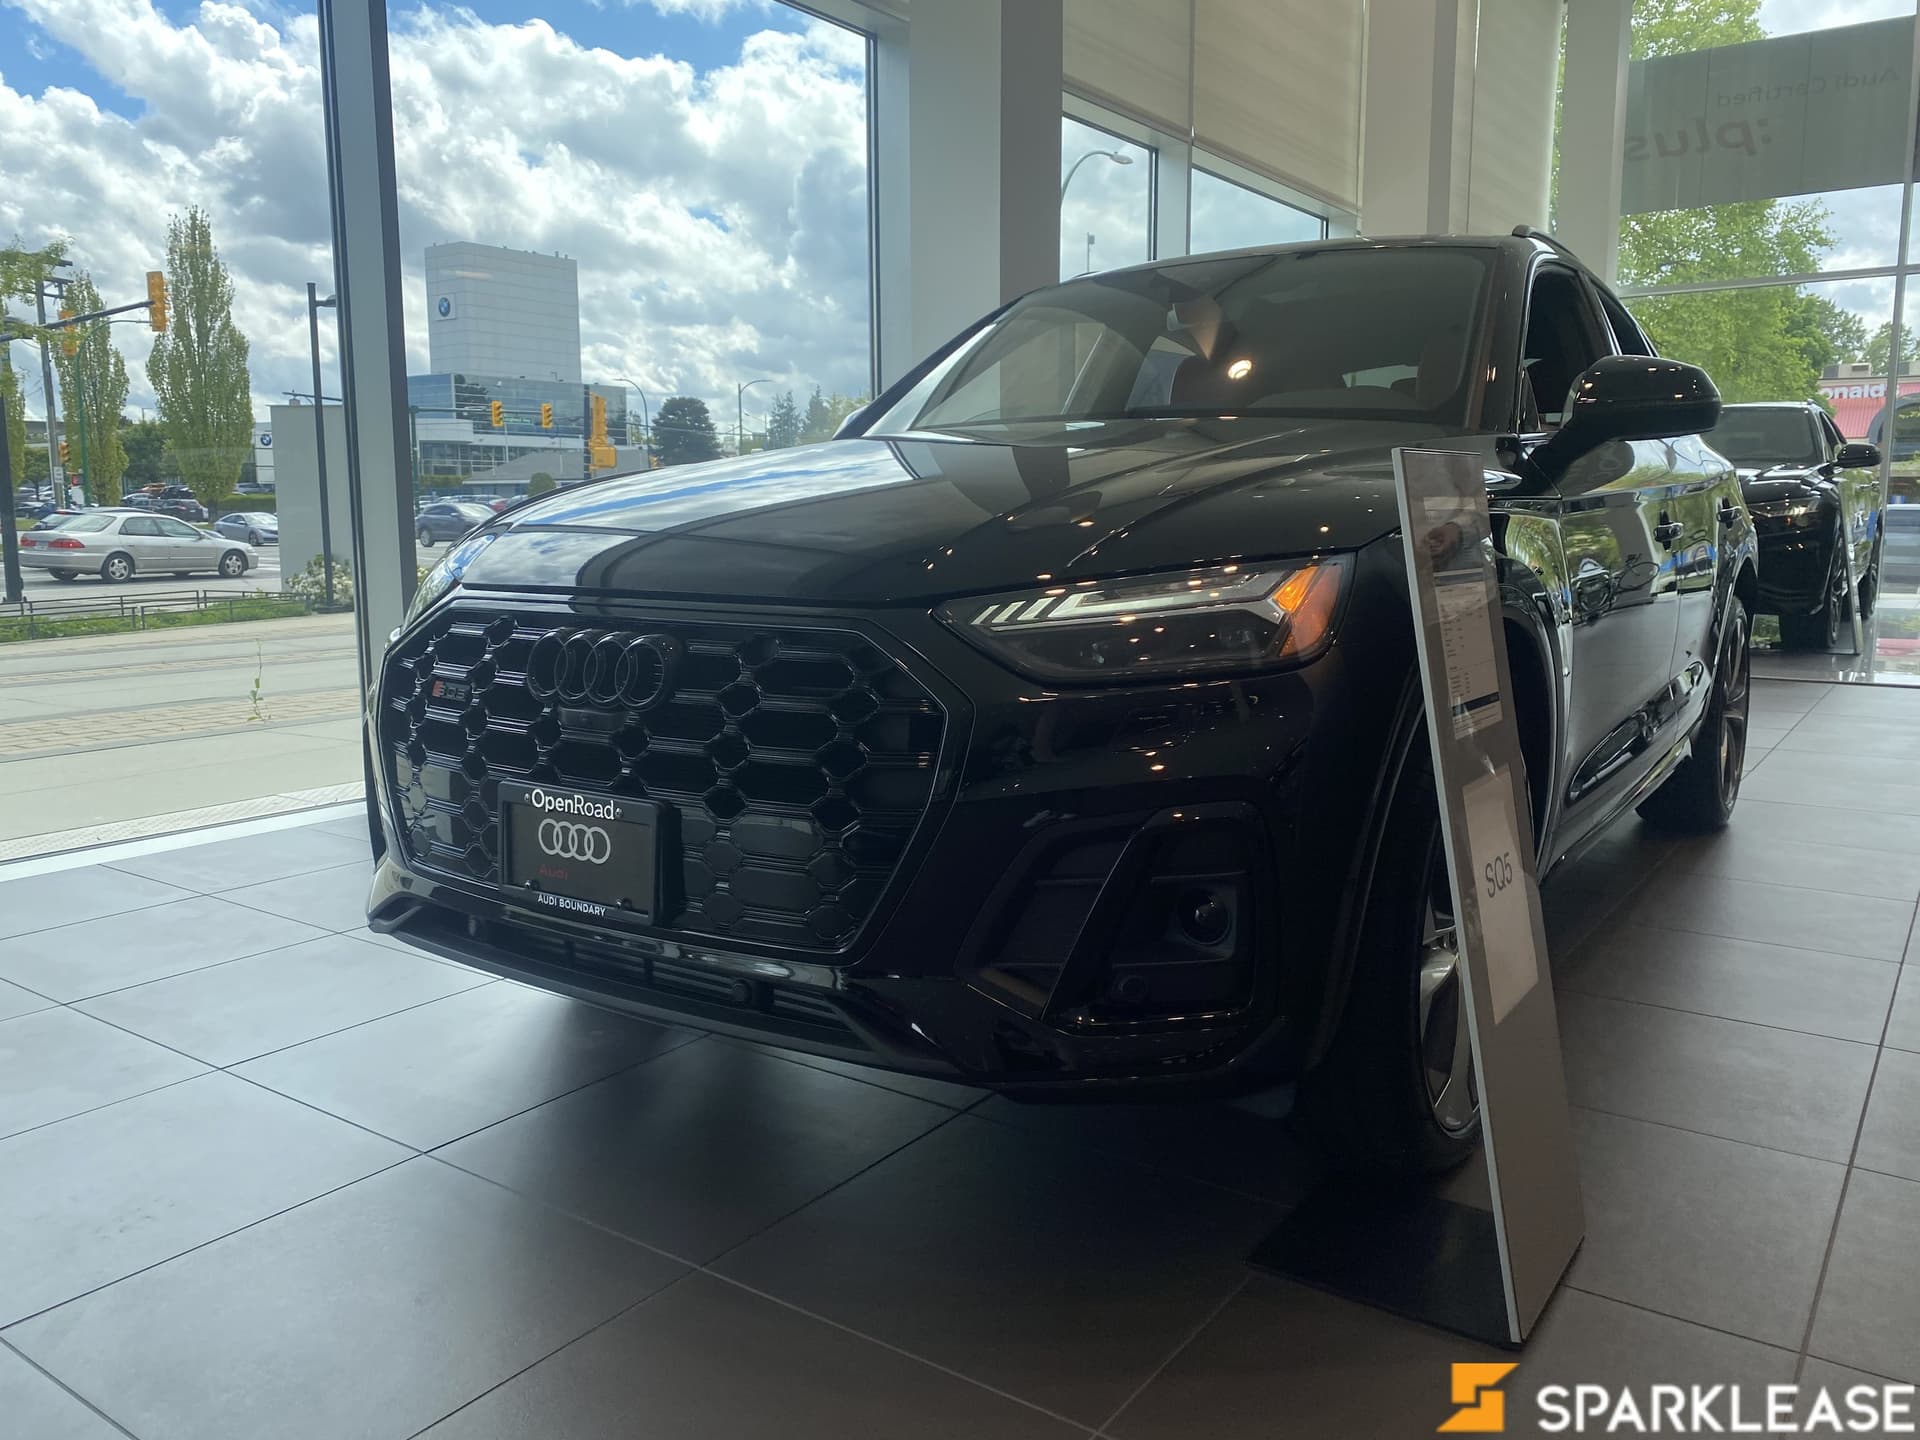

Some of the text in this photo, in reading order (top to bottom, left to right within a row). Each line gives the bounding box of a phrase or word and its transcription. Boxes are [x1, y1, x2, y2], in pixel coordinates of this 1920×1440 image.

[1817, 383, 1900, 401] onald
[531, 788, 615, 820] OpenRoad
[1484, 852, 1513, 899] SQ5
[537, 894, 606, 917] AUDI BOUNDARY
